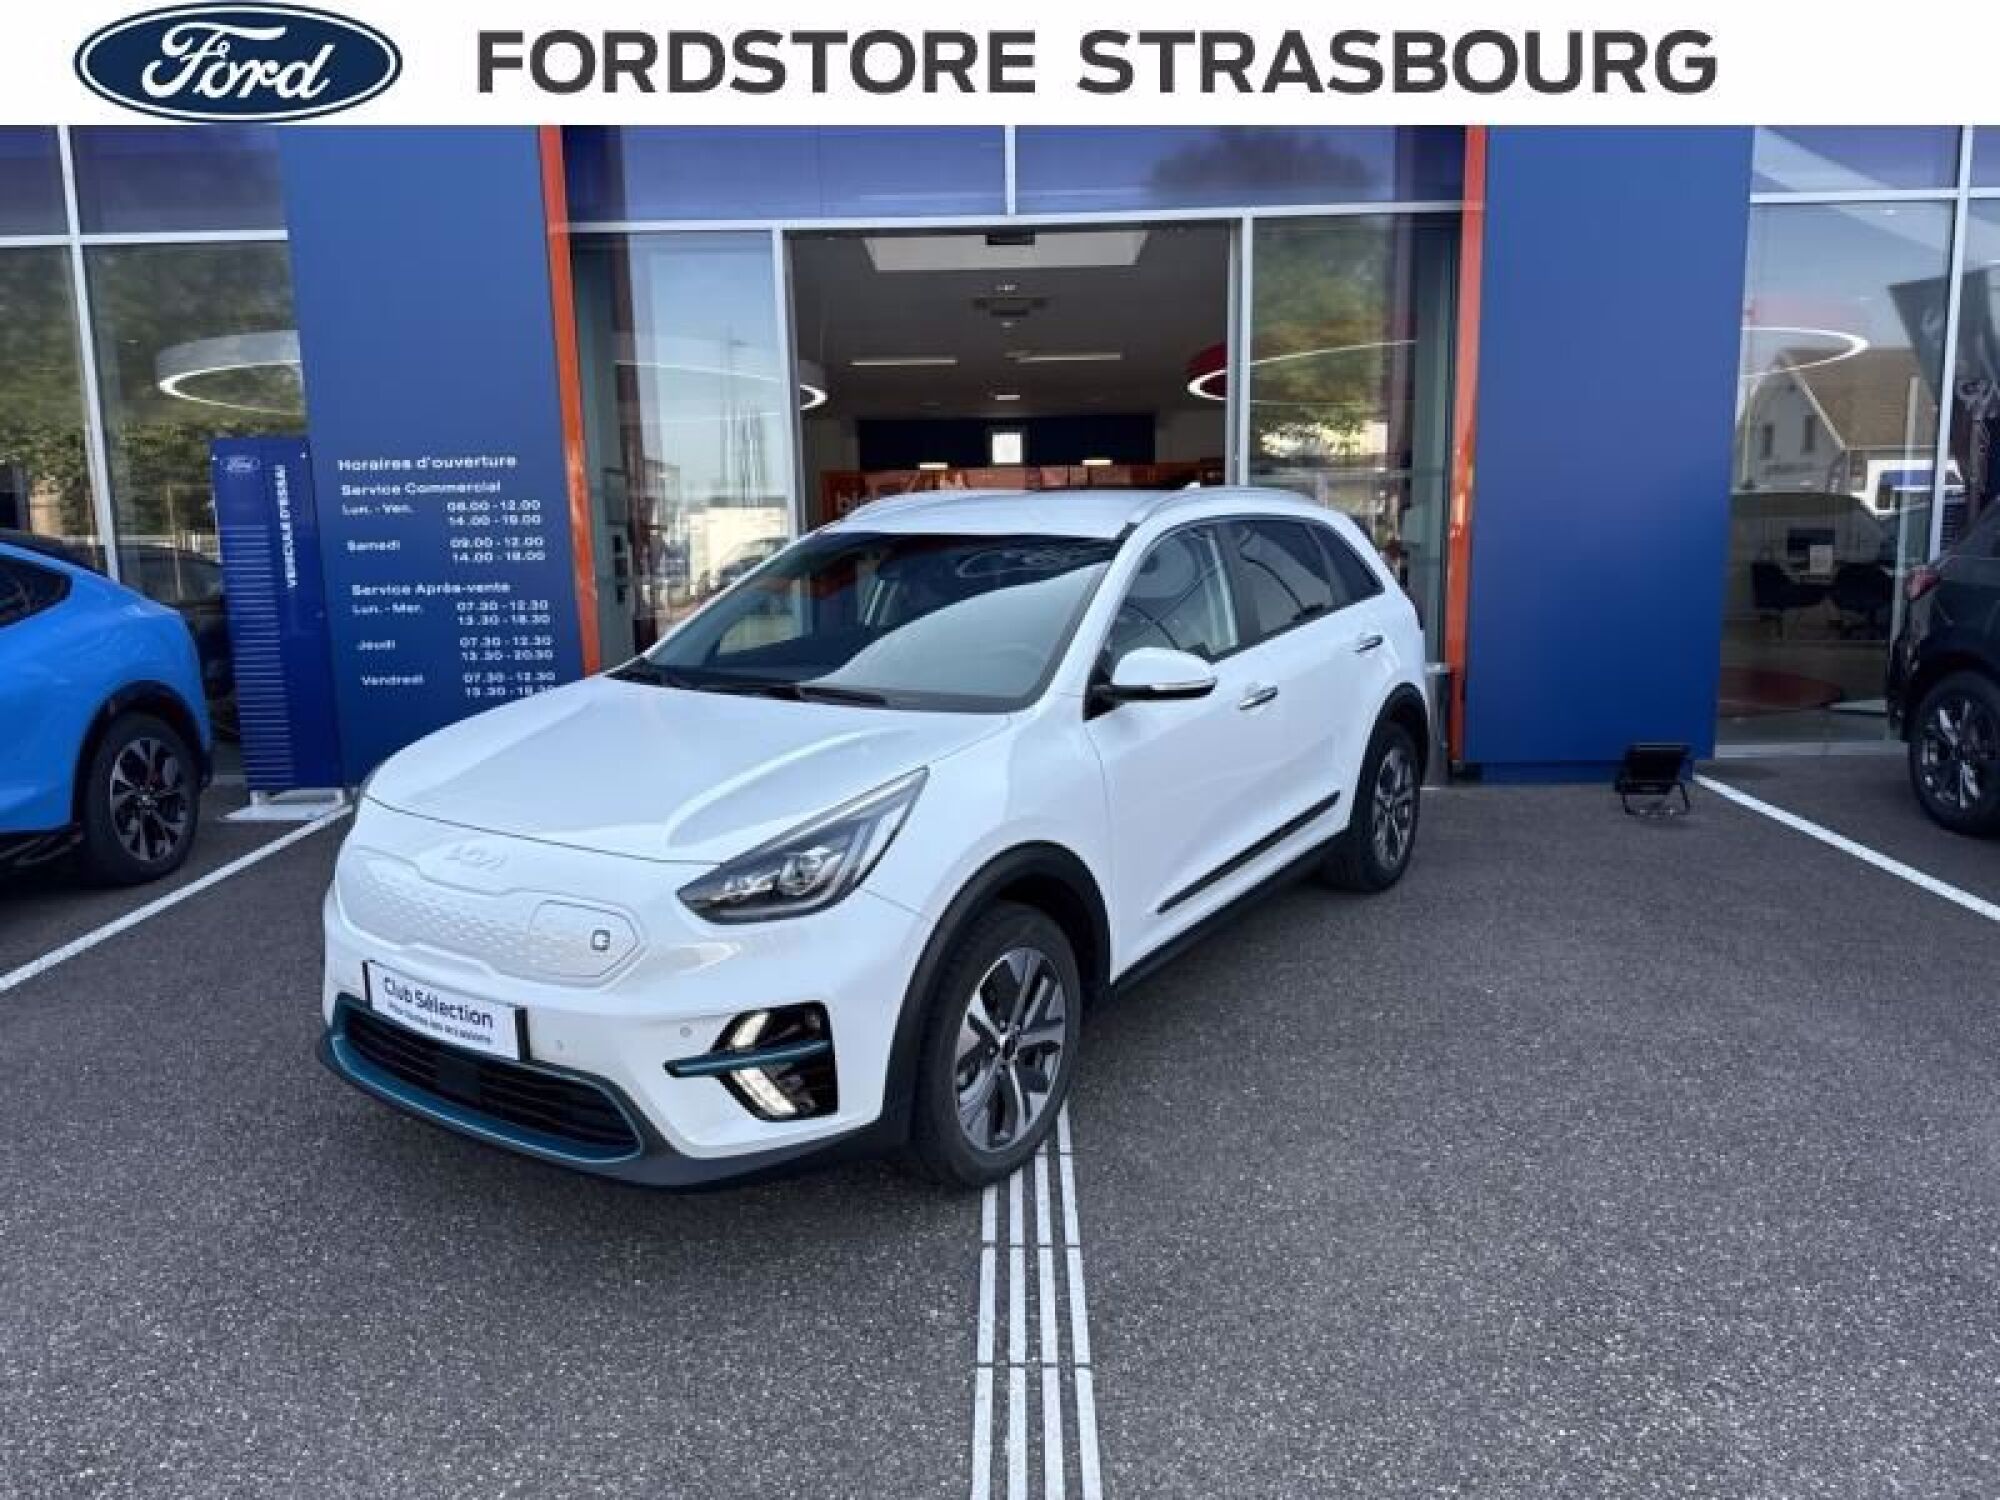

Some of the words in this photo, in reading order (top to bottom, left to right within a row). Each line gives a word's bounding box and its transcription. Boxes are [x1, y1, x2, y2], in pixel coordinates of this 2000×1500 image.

[337, 458, 411, 471] Horaires
[416, 455, 517, 470] d'ouverture
[341, 483, 401, 496] Service
[404, 481, 501, 494] Commercial
[347, 540, 401, 551] Samedi
[352, 584, 410, 596] Service
[358, 639, 396, 650] Jeudi
[361, 674, 425, 685] Vendredi
[384, 976, 413, 1004] Club
